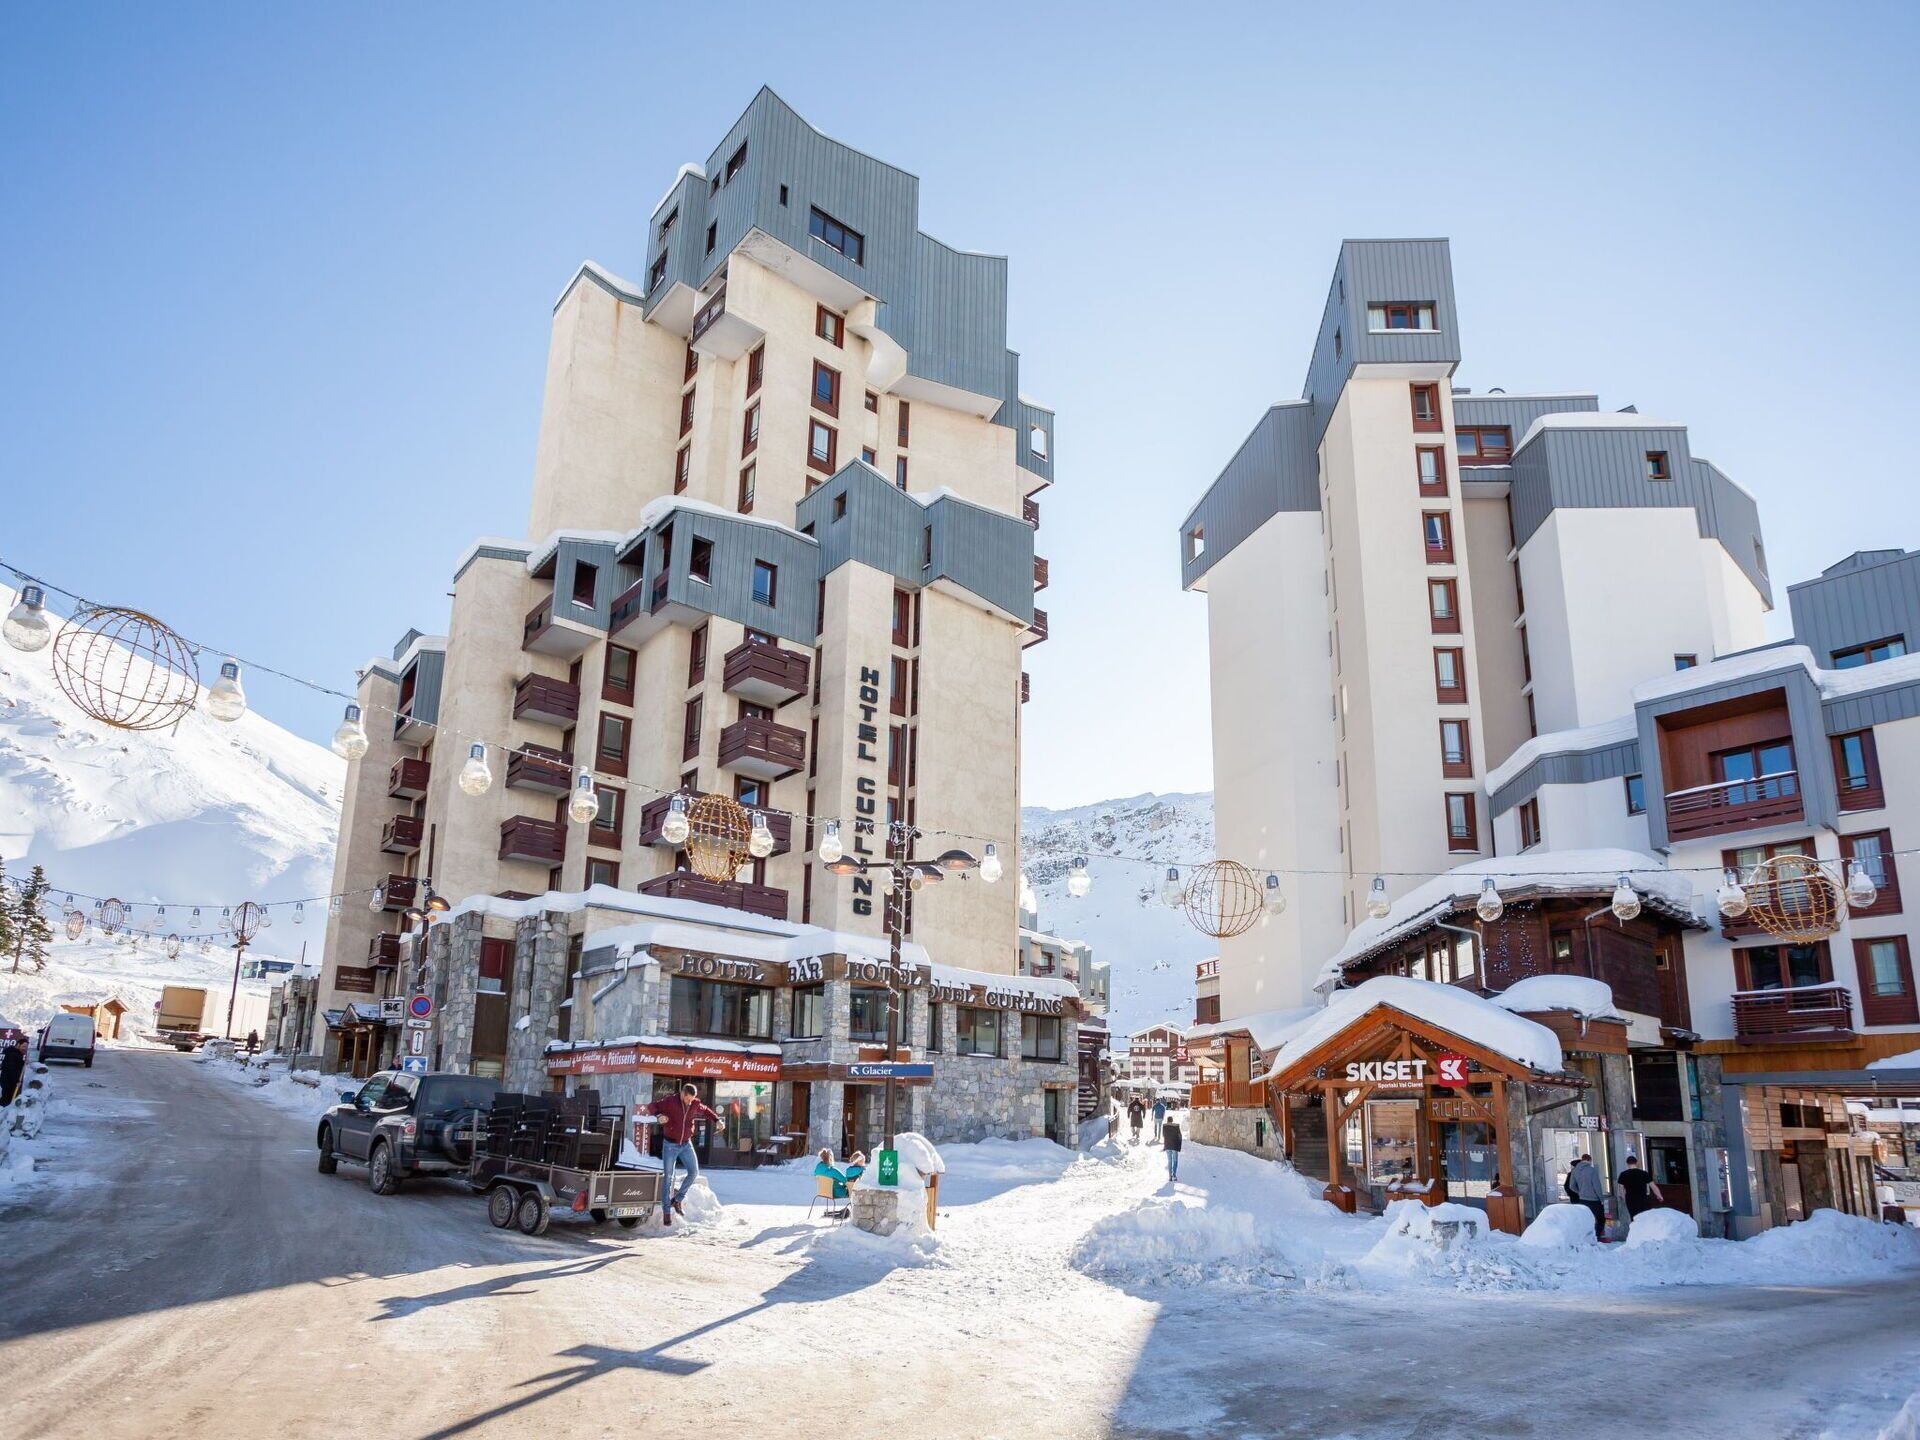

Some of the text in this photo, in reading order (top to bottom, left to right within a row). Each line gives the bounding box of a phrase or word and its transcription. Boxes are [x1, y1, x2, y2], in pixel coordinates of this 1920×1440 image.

[853, 666, 879, 916] HOTEL CURLING
[679, 955, 764, 981] HOTEL
[788, 957, 823, 982] BAR
[845, 961, 922, 986] HOTEL
[986, 990, 1064, 1015] CURLING
[640, 1054, 654, 1063] Pain
[655, 1055, 684, 1065] Artisanal
[742, 1061, 778, 1073] Pâtisserie
[703, 1066, 722, 1075] Artisan
[862, 1066, 893, 1076] Glacier
[1346, 1060, 1427, 1082] SKISET
